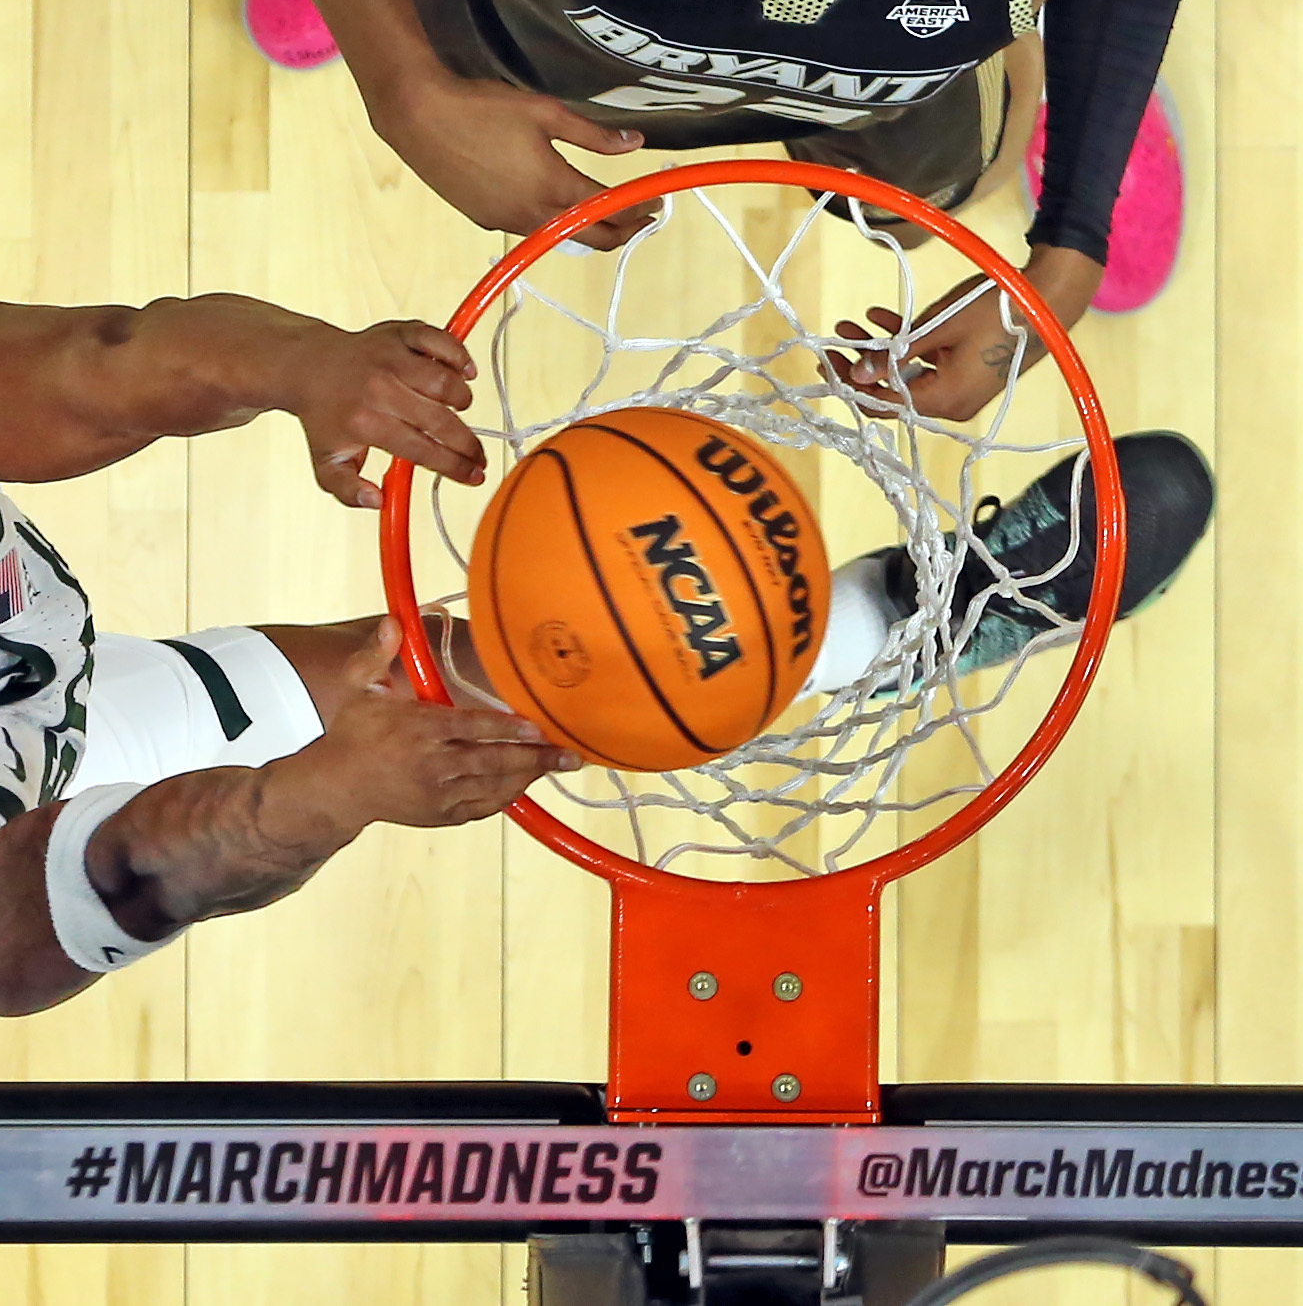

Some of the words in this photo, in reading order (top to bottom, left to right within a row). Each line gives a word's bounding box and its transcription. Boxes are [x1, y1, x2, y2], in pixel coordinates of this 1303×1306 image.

[890, 6, 967, 22] AMERICA
[906, 17, 948, 26] EAST
[574, 14, 952, 105] BRYANT
[696, 435, 811, 662] Wilson
[630, 513, 742, 680] NCAA
[65, 1141, 663, 1205] #MARCHMADNESS
